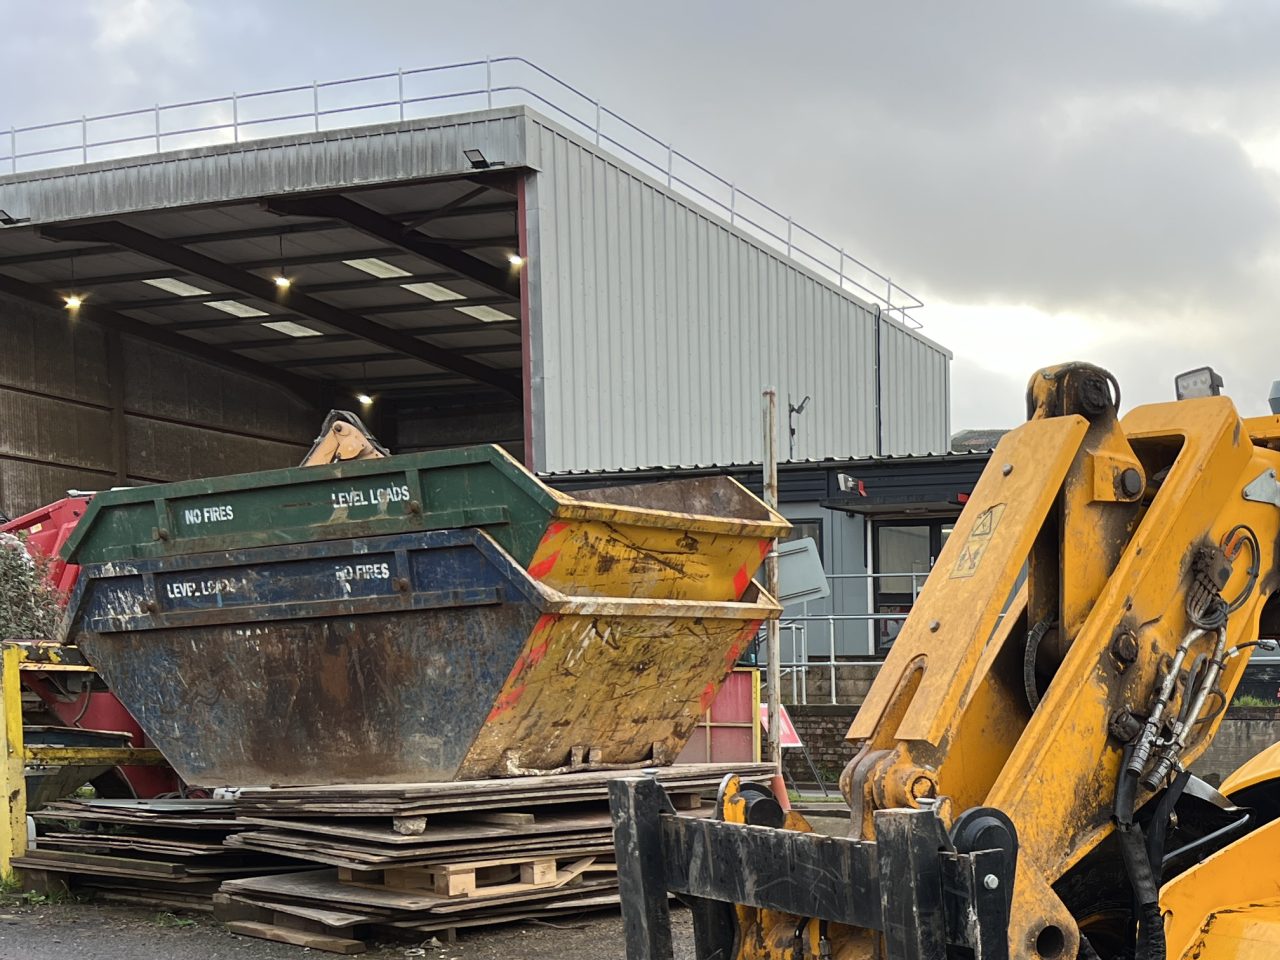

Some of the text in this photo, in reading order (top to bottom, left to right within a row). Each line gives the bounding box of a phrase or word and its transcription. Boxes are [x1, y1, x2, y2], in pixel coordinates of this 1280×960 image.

[331, 485, 411, 509] LEVEL LOADS
[184, 505, 234, 525] NO FIRES
[355, 562, 390, 580] FIRES
[166, 582, 200, 598] LEVEL
